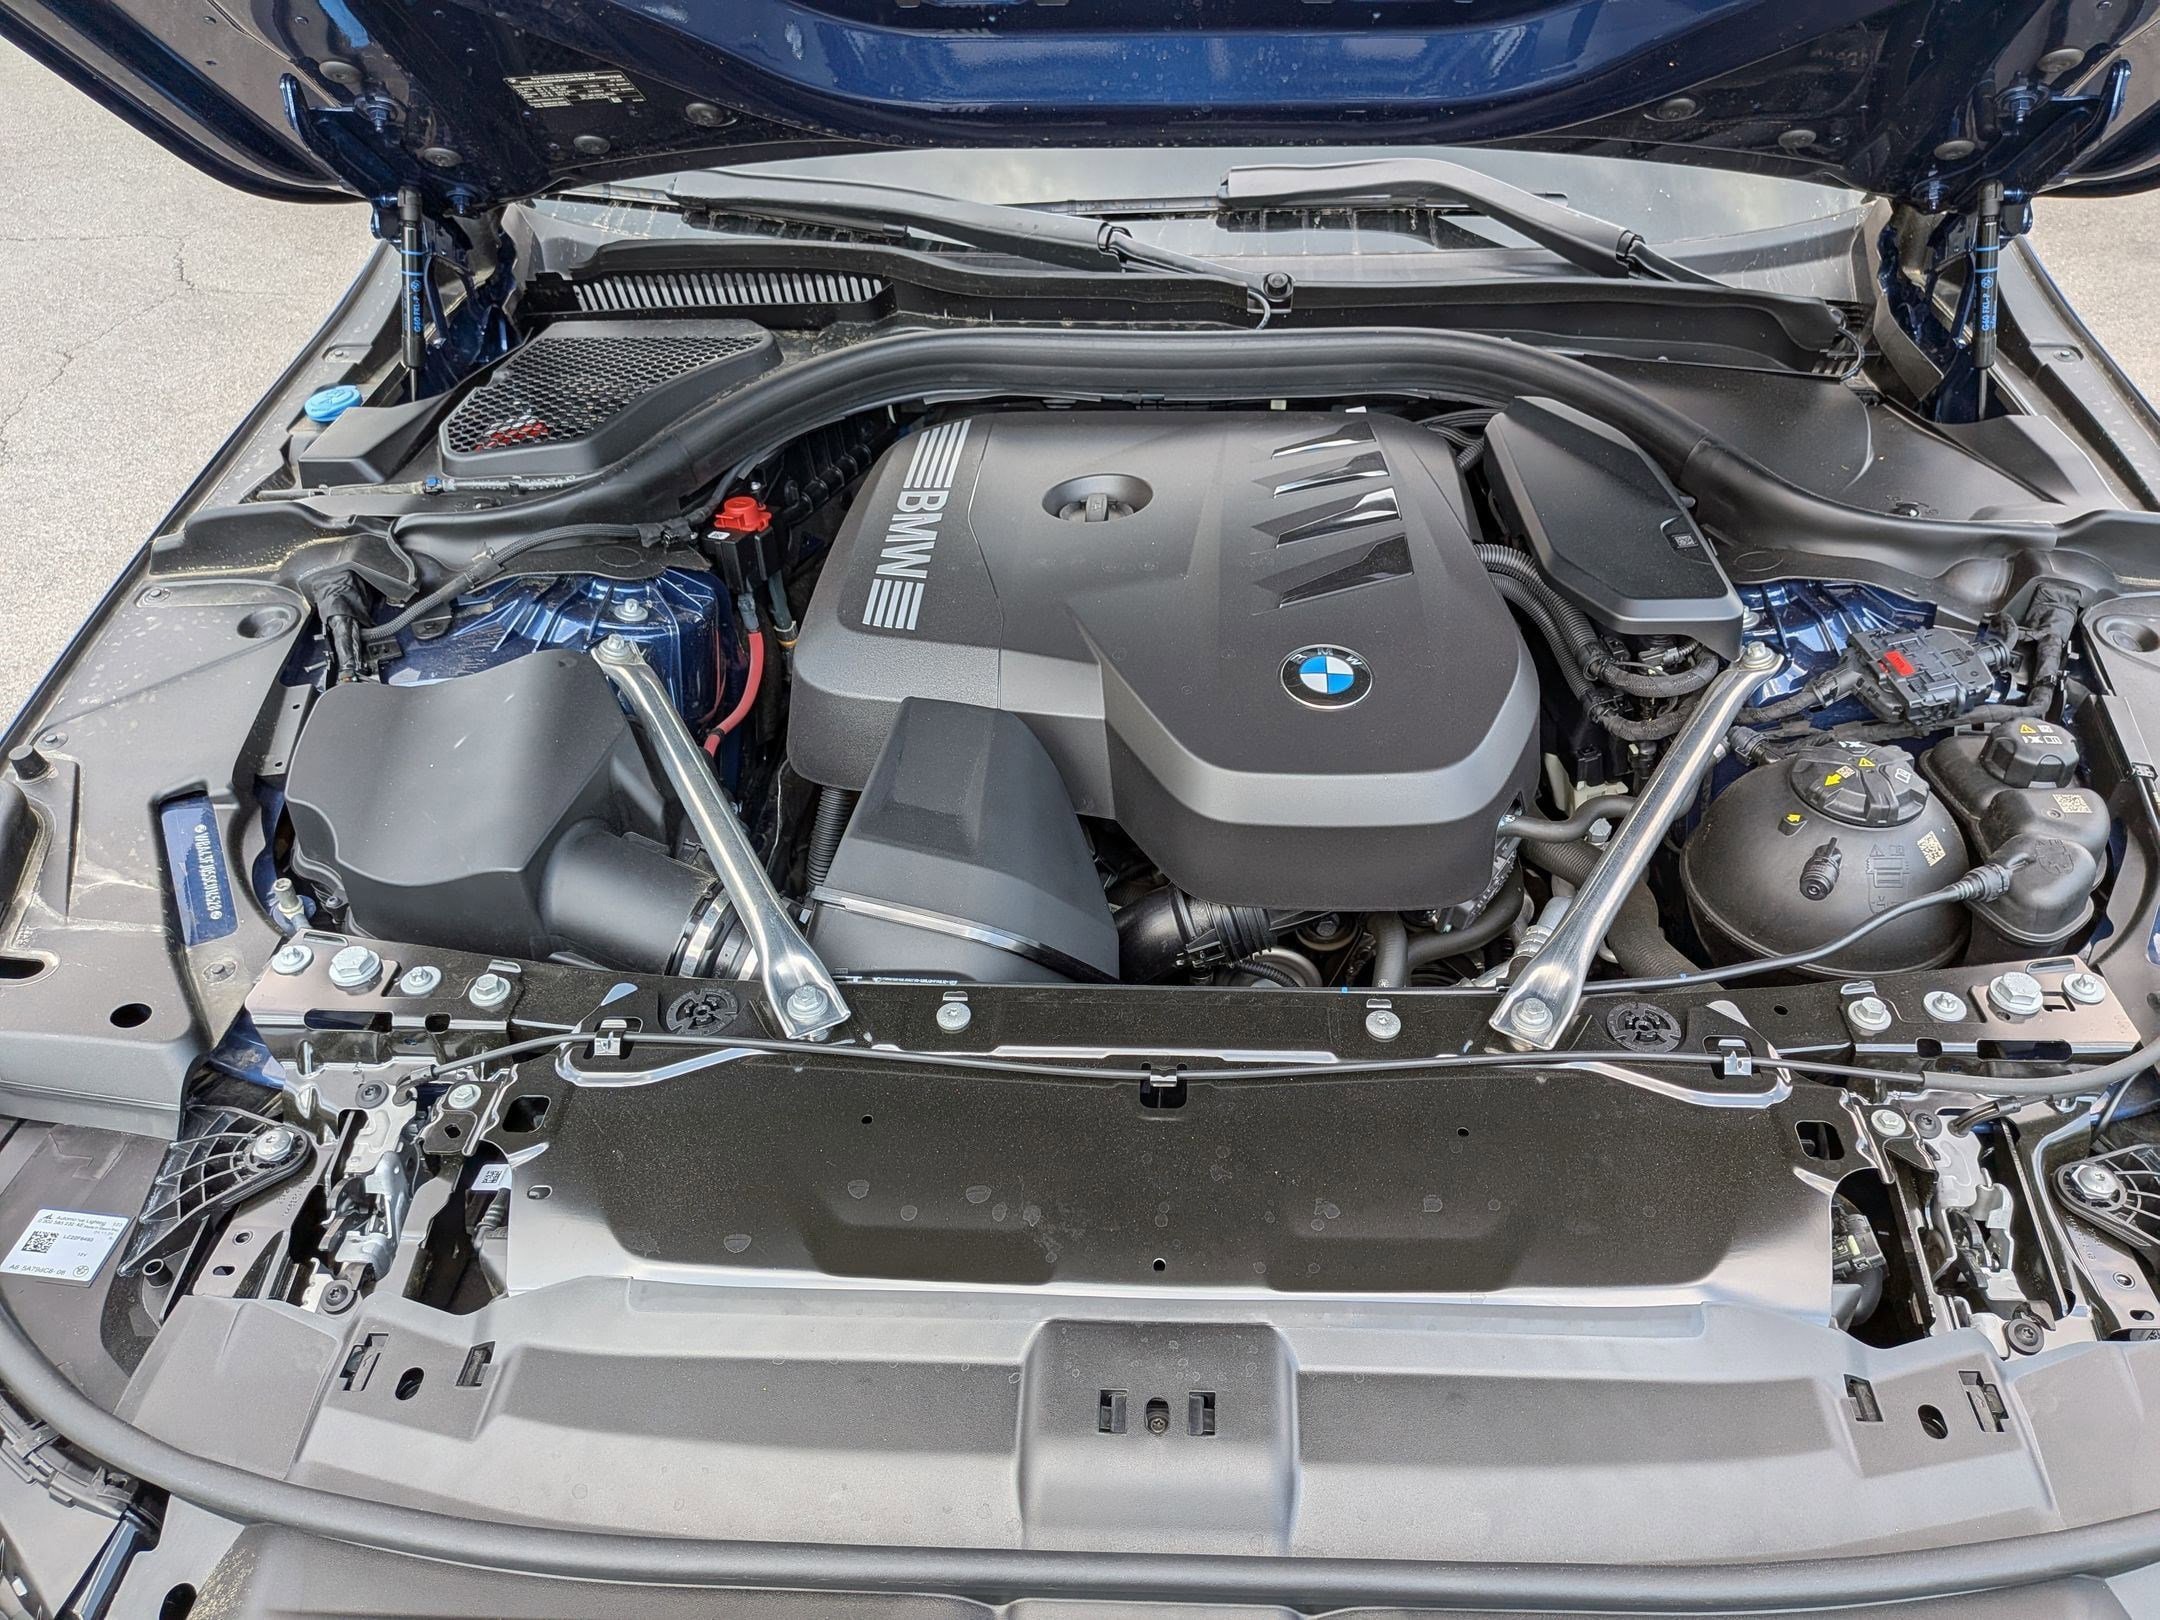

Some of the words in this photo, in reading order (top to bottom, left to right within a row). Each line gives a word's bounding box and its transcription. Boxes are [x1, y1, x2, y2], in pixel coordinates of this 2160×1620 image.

[413, 317, 421, 332] G60
[1981, 314, 1990, 331] G60
[874, 490, 950, 579] BMW
[1290, 647, 1364, 666] BMW
